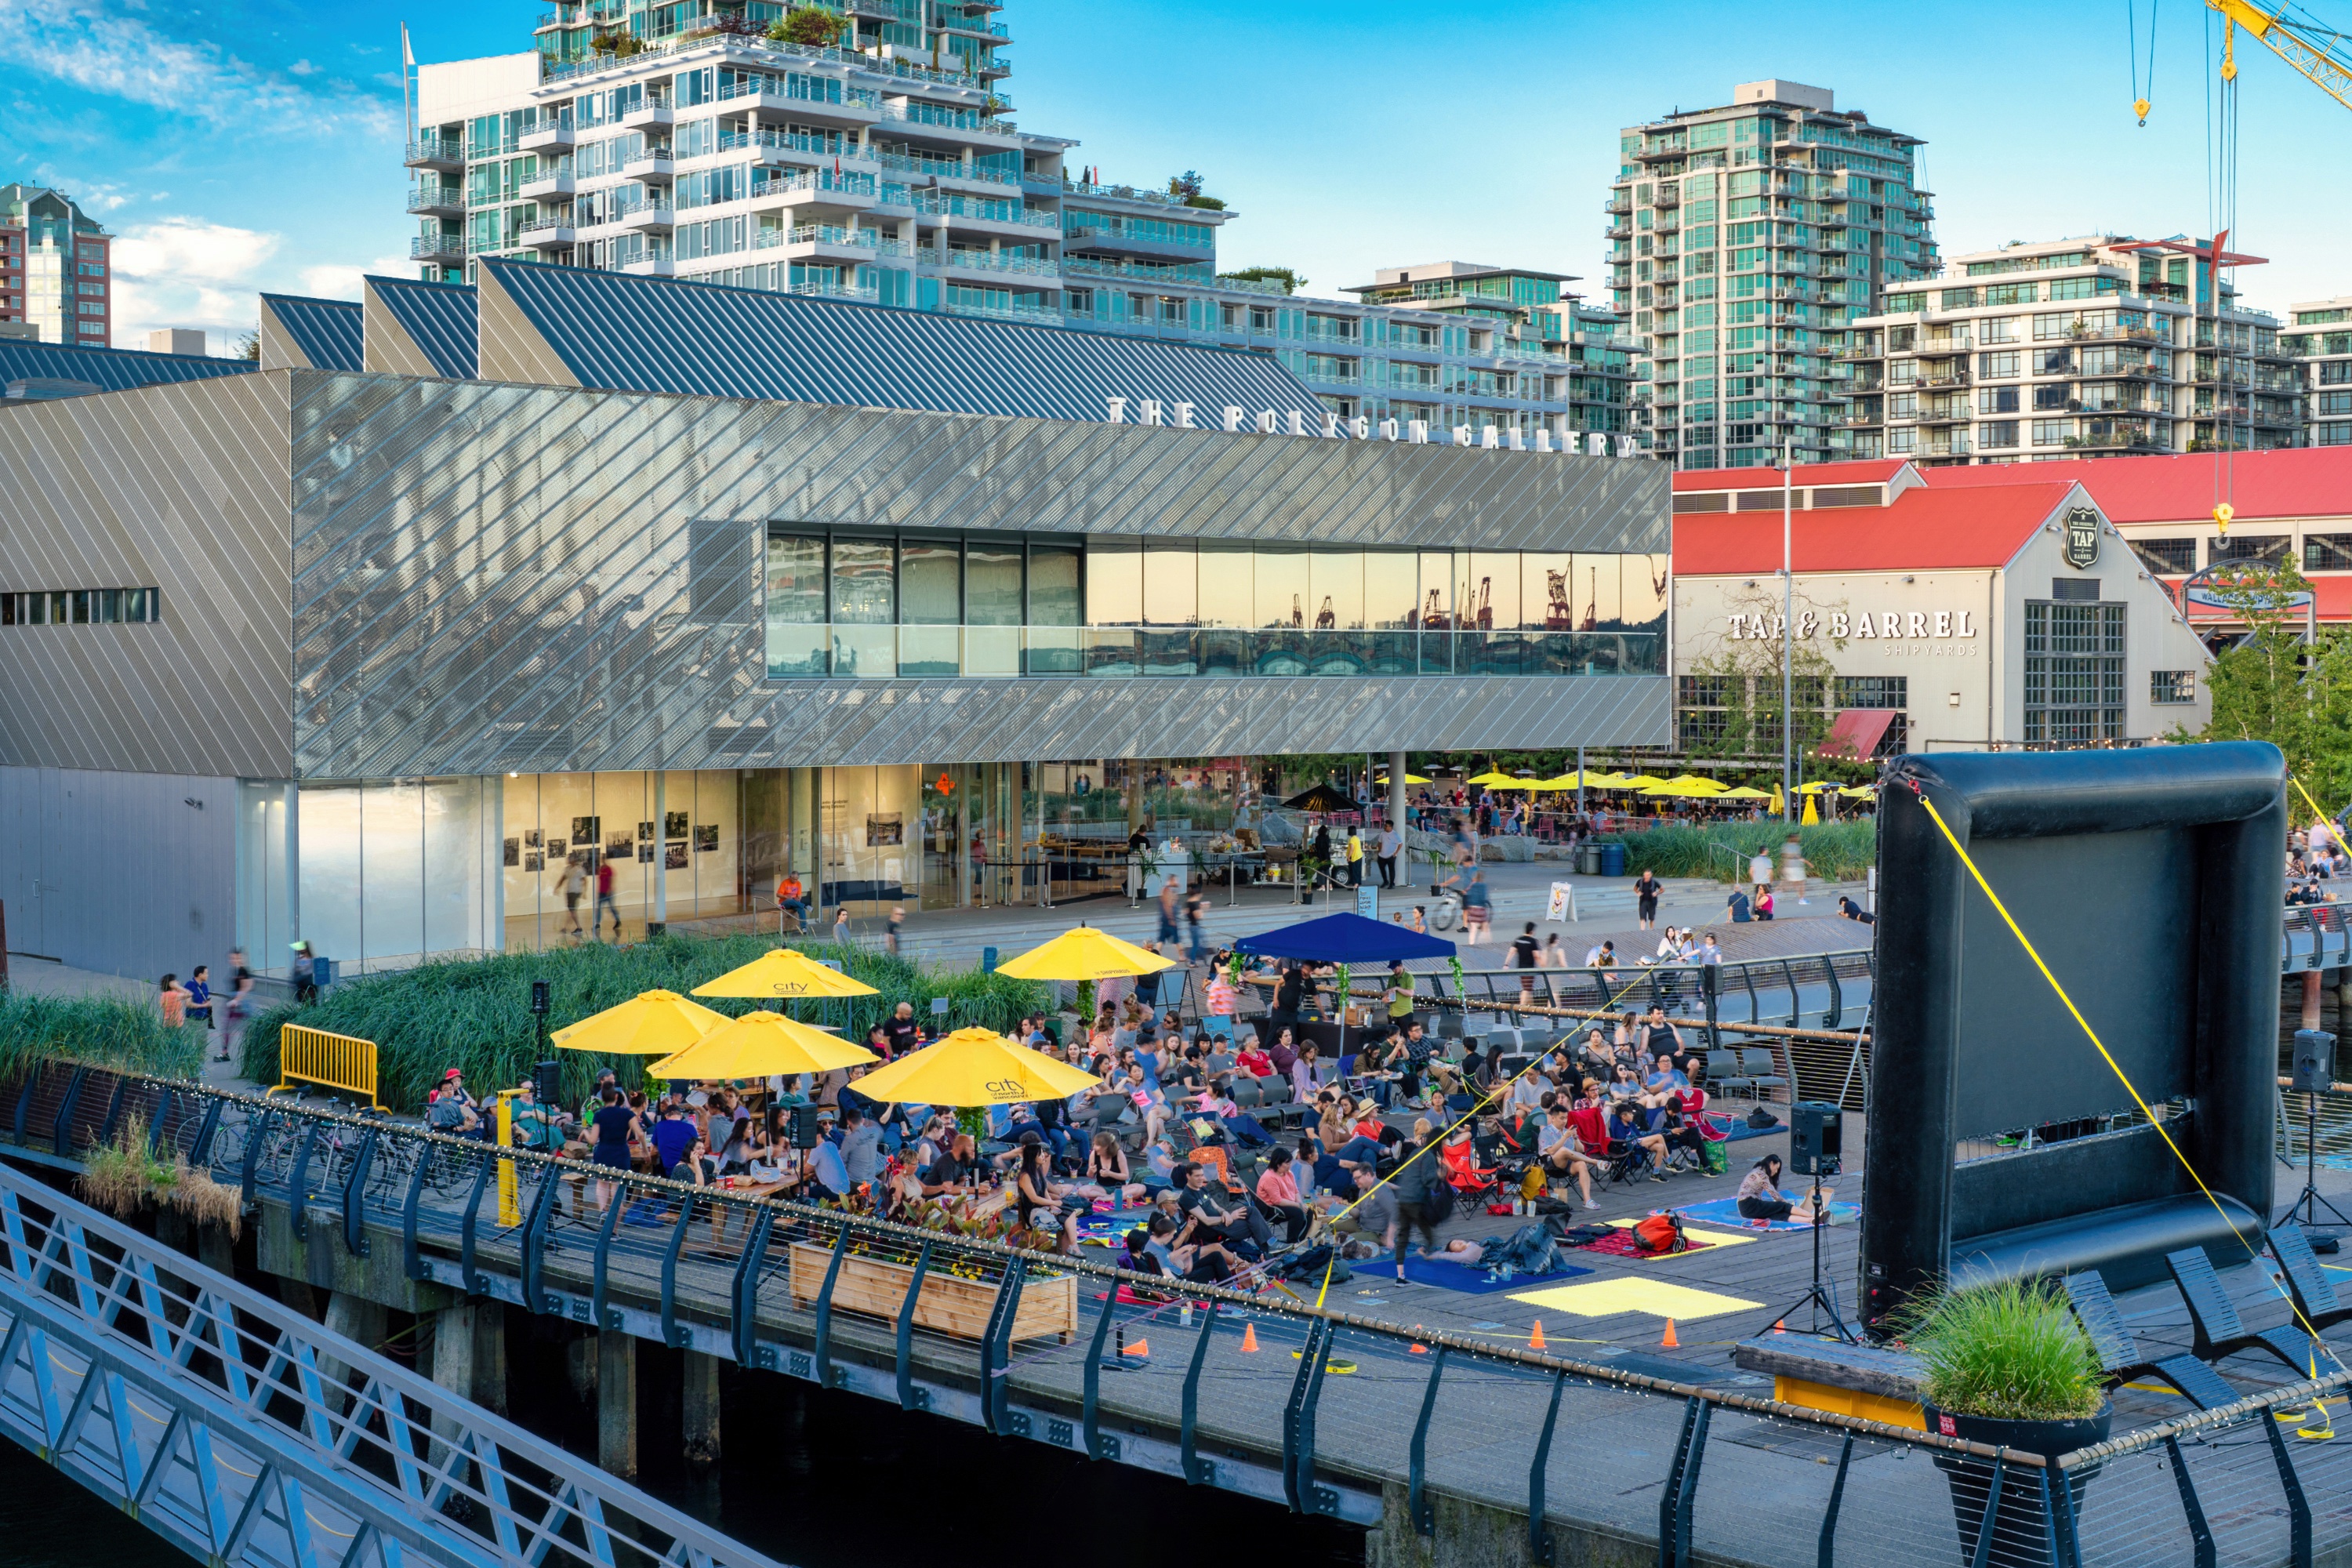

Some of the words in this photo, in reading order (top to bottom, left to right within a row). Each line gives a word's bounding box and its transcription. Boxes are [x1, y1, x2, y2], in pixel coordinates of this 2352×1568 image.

[1106, 397, 1195, 429] THE
[1224, 405, 1428, 445] POLYGON
[1454, 423, 1633, 458] GALLERY
[2072, 531, 2095, 547] TAP
[1798, 611, 1819, 639] &
[1831, 612, 1976, 638] BARREL
[1884, 644, 1977, 656] SHIPYARDS
[773, 982, 808, 993] city
[985, 1078, 1025, 1094] city
